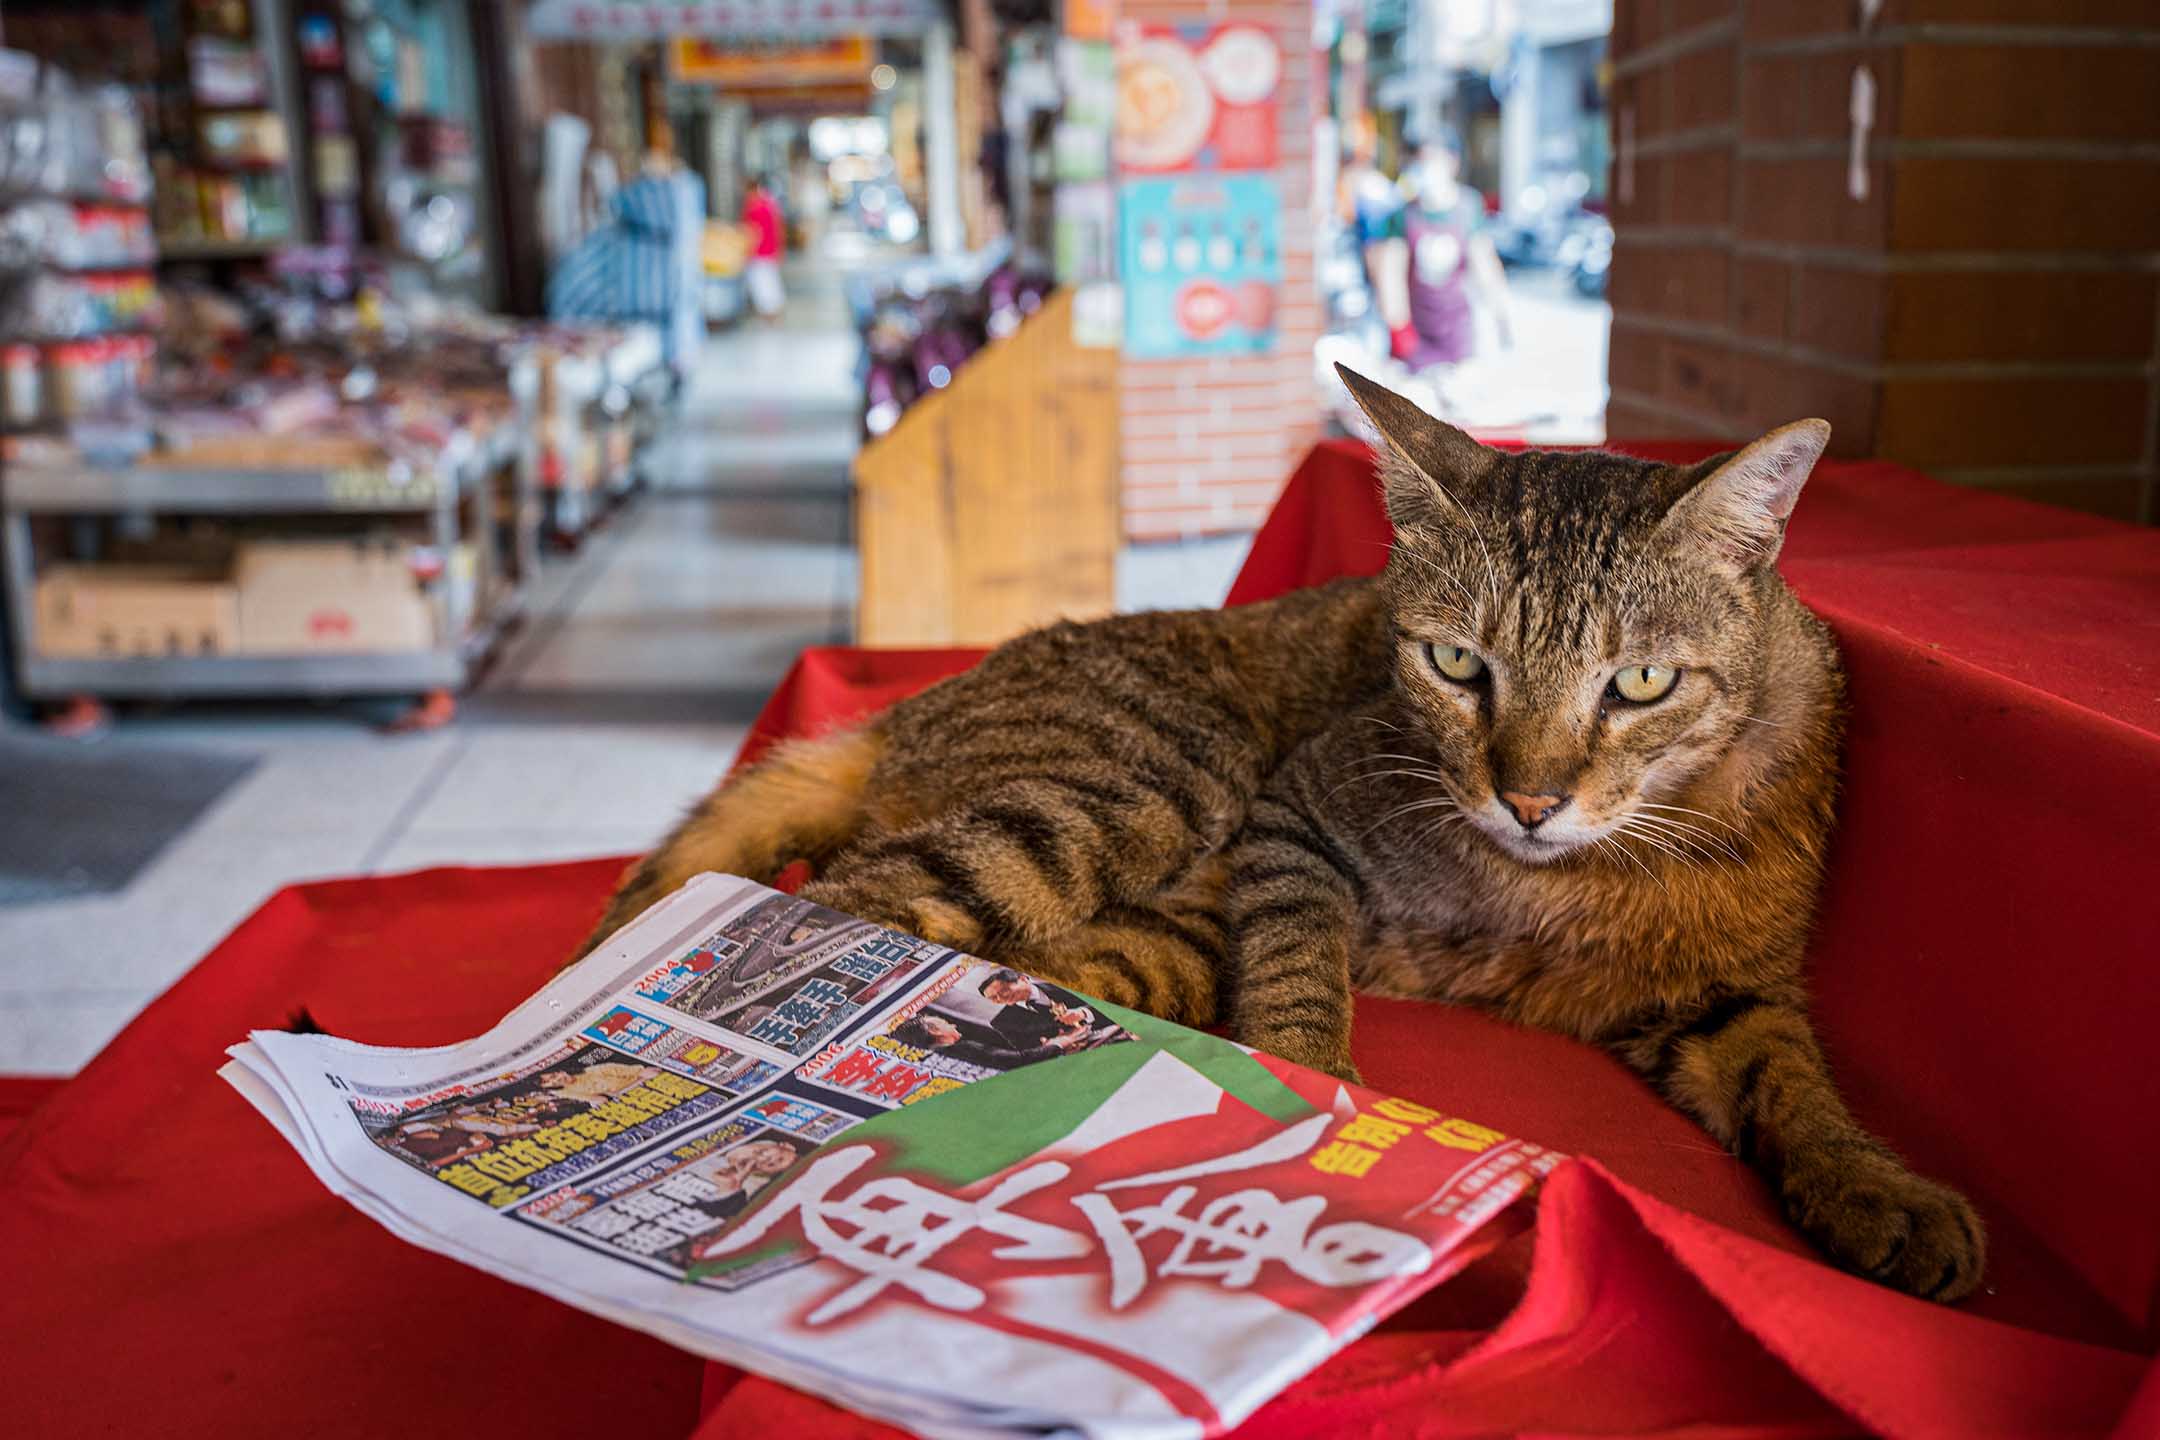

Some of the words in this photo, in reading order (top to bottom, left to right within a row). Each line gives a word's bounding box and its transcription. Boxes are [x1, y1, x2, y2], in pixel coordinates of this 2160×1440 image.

[636, 959, 679, 990] 2004
[750, 979, 847, 1045] 手牽手
[797, 1042, 845, 1079] 2006
[353, 1096, 402, 1115] 2003
